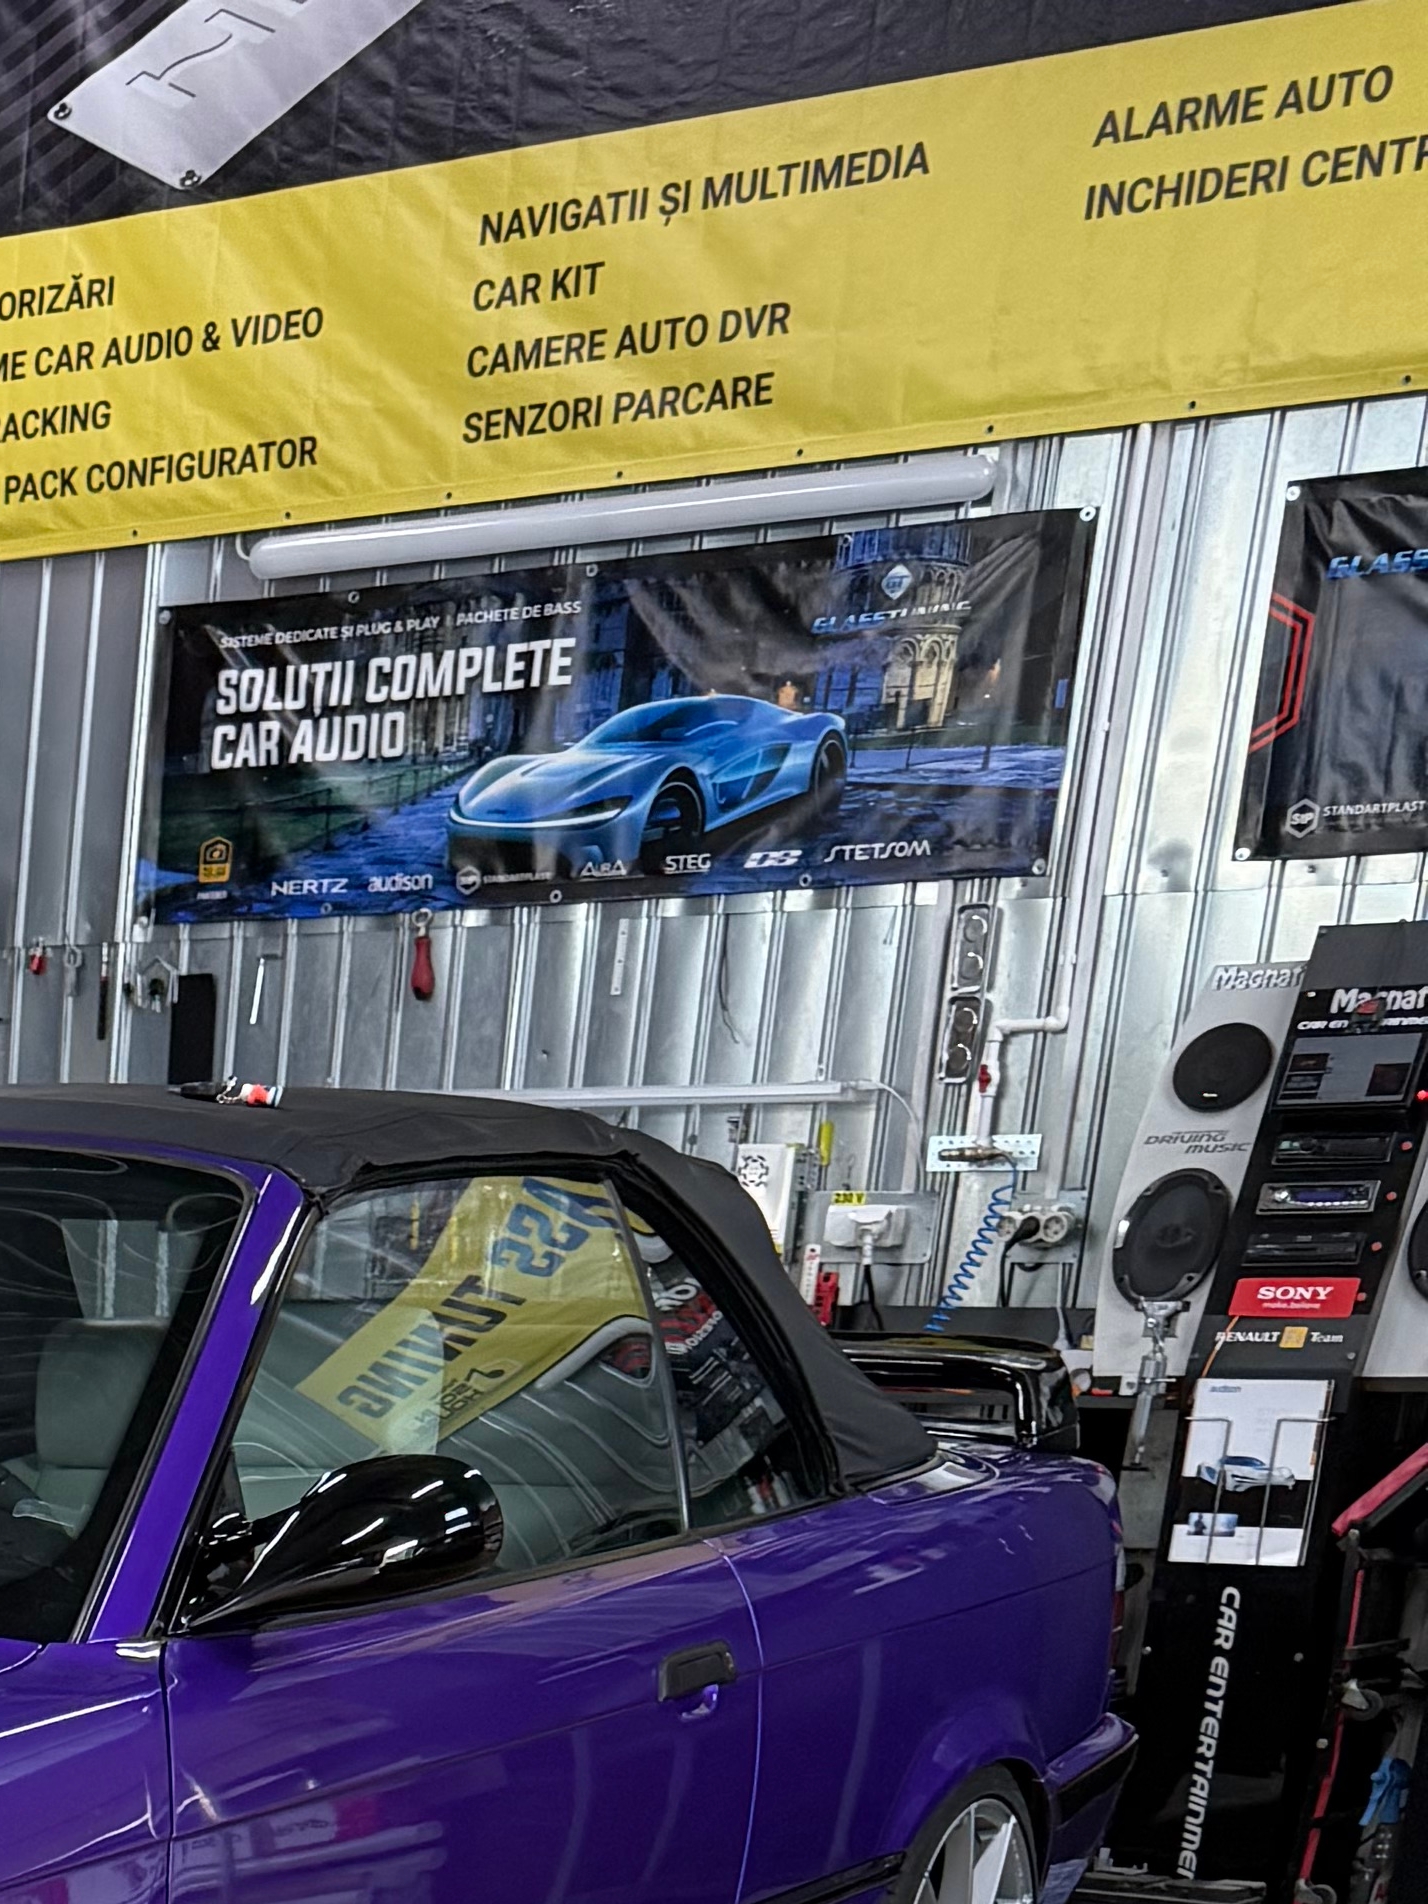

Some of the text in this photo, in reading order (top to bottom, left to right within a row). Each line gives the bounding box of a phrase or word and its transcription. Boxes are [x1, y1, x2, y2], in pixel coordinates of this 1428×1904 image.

[1092, 65, 1394, 148] ALARME AUTO
[479, 187, 649, 246] NAVIGATII
[701, 142, 930, 210] MULTIMEDIA
[1084, 155, 1290, 221] INCHIDERI
[473, 261, 605, 311] CAR KIT
[35, 341, 94, 377] CAR
[102, 326, 193, 368] AUDIO
[202, 322, 221, 352] &
[231, 307, 324, 348] VIDEO
[467, 302, 792, 377] CAMERE AUTO DVR
[463, 372, 775, 444] SENZORI PARCARE
[4, 467, 78, 504] PACK
[86, 436, 318, 494] CONFIGURATOR
[219, 633, 275, 650] SISTEME
[275, 626, 339, 645] DEDICATE
[355, 621, 392, 638] PLUG
[393, 618, 404, 633] &
[406, 616, 441, 632] PLAY
[456, 607, 521, 627] PACHETE
[522, 604, 542, 620] DE
[543, 601, 583, 617] BASS
[365, 637, 577, 704] COMPLETE
[211, 711, 406, 770] CAR AUDIO
[663, 853, 712, 872] STEG
[824, 839, 932, 863] STETSOM
[1212, 965, 1308, 991] Magnat
[1257, 1286, 1334, 1300] SONY
[1215, 1331, 1280, 1343] RENAULT
[1213, 1586, 1241, 1650] CAR
